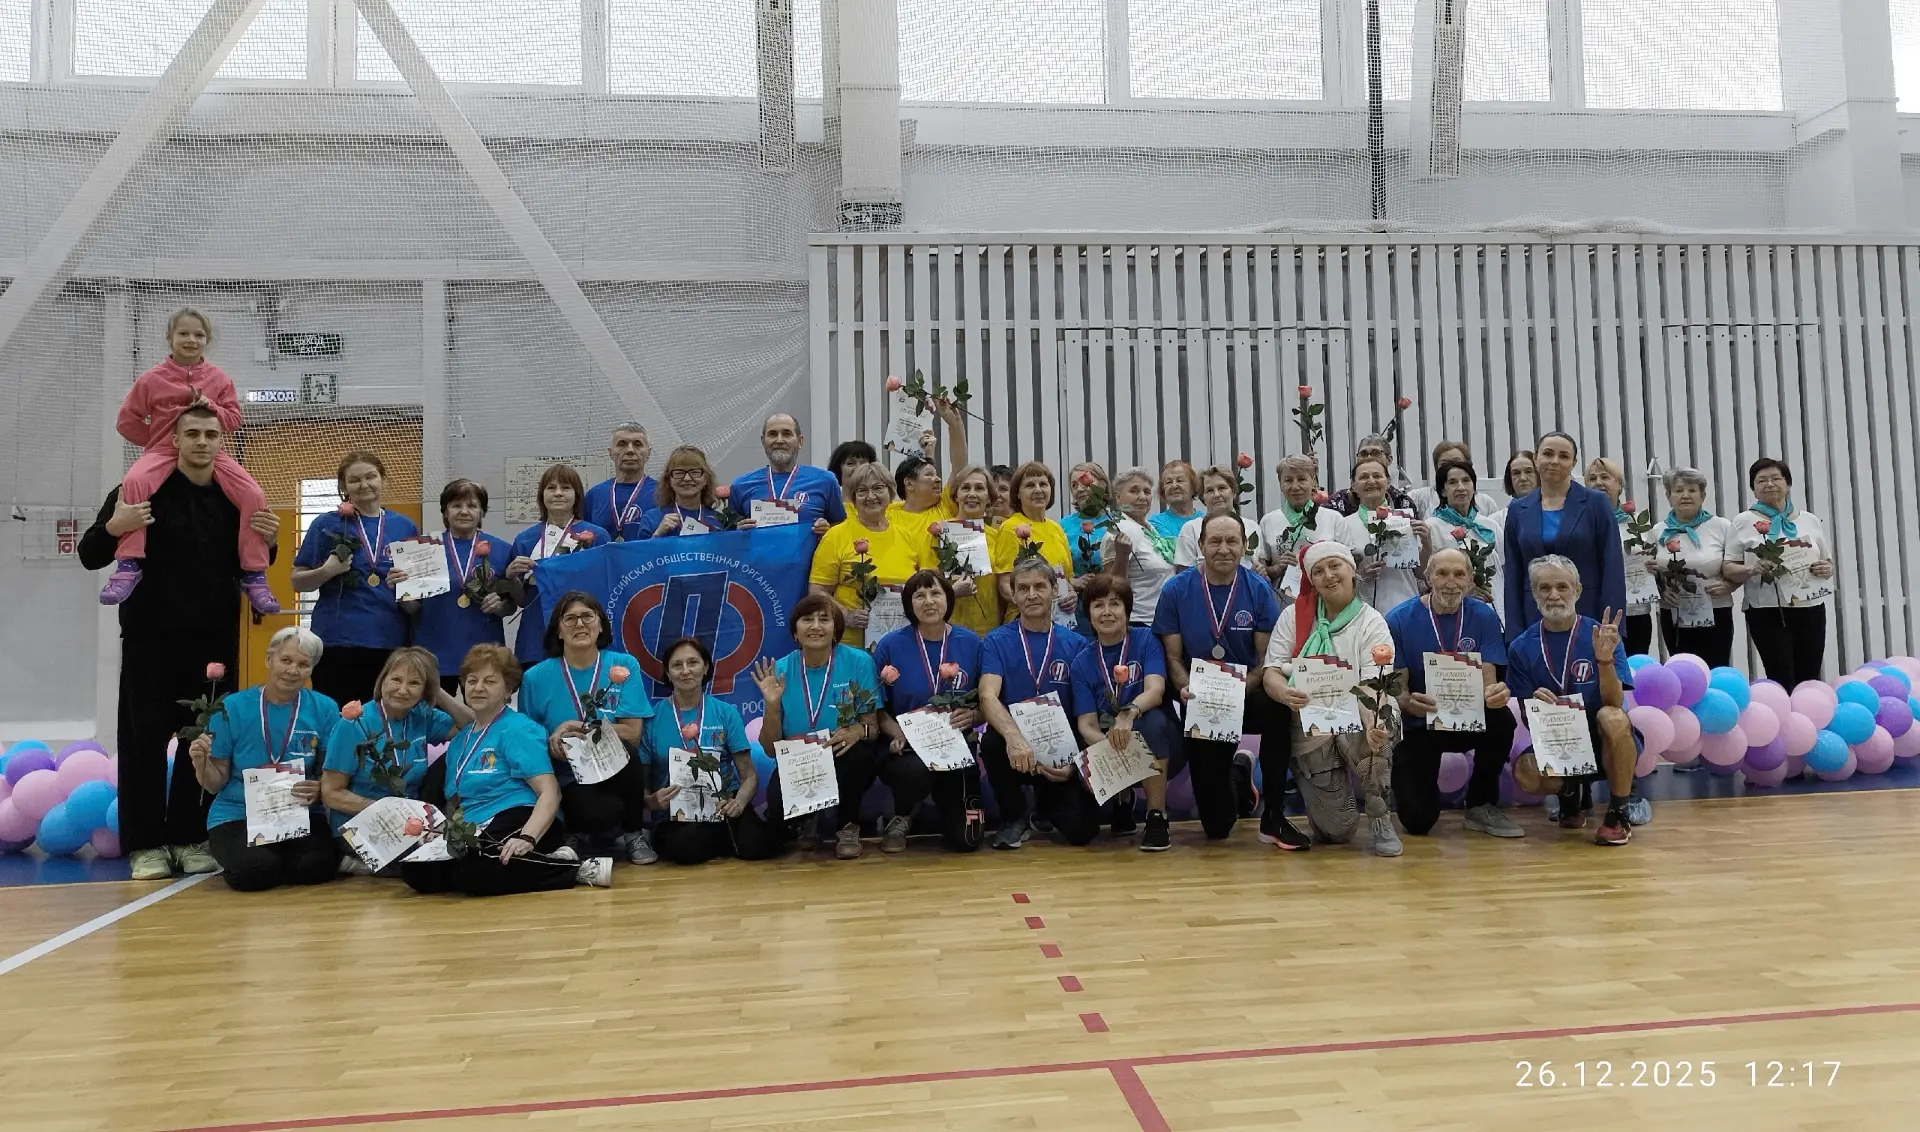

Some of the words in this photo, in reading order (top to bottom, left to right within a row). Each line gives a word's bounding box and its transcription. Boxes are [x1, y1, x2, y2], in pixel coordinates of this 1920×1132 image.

[606, 561, 654, 622] ЕРОССИЙСКАЯ
[656, 552, 740, 569] ОБЩЕСТВЕННАЯ
[741, 564, 785, 627] ОРГАНИЗАЦИЯ
